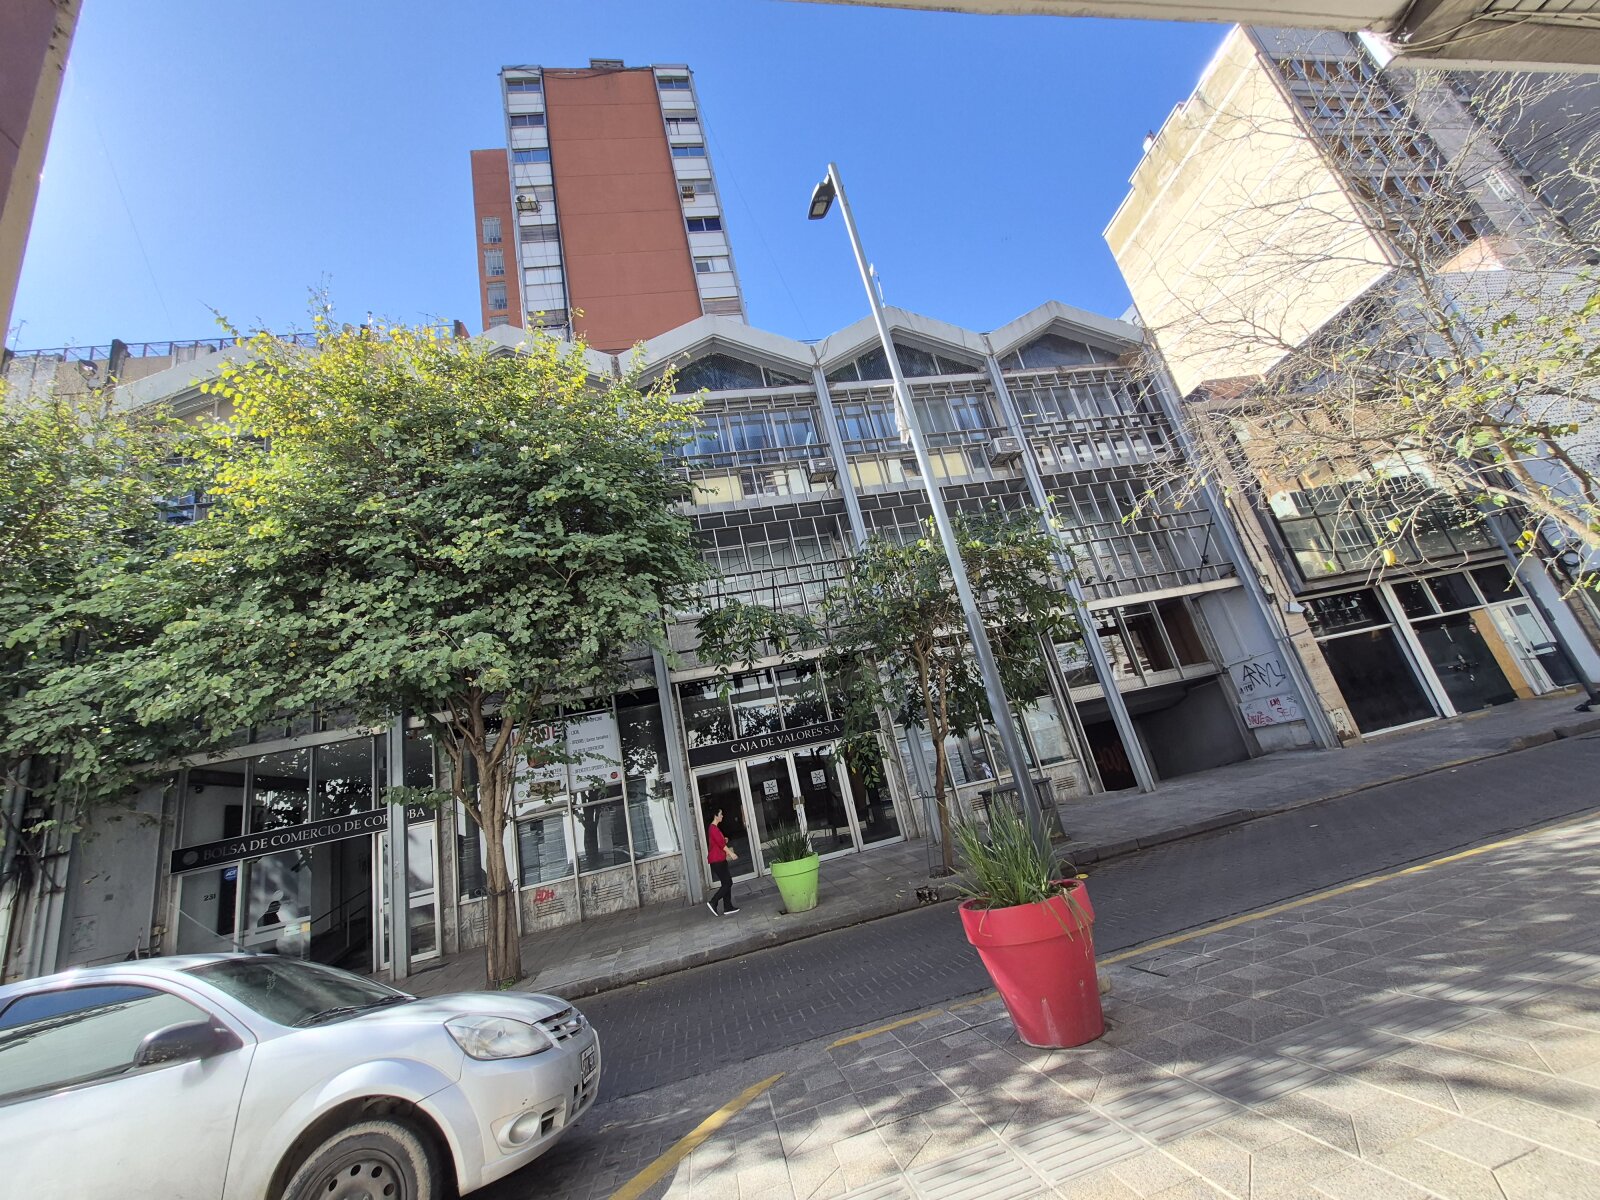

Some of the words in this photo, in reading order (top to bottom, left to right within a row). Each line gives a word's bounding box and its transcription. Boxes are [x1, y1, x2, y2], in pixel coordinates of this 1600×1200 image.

[730, 742, 759, 753] CAJA
[760, 736, 775, 748] DE
[776, 727, 823, 744] VALORES
[203, 842, 247, 861] BOLSA
[249, 837, 268, 851] DE
[270, 823, 341, 846] COMERCIO
[344, 819, 362, 832] DE
[203, 893, 217, 901] 231
